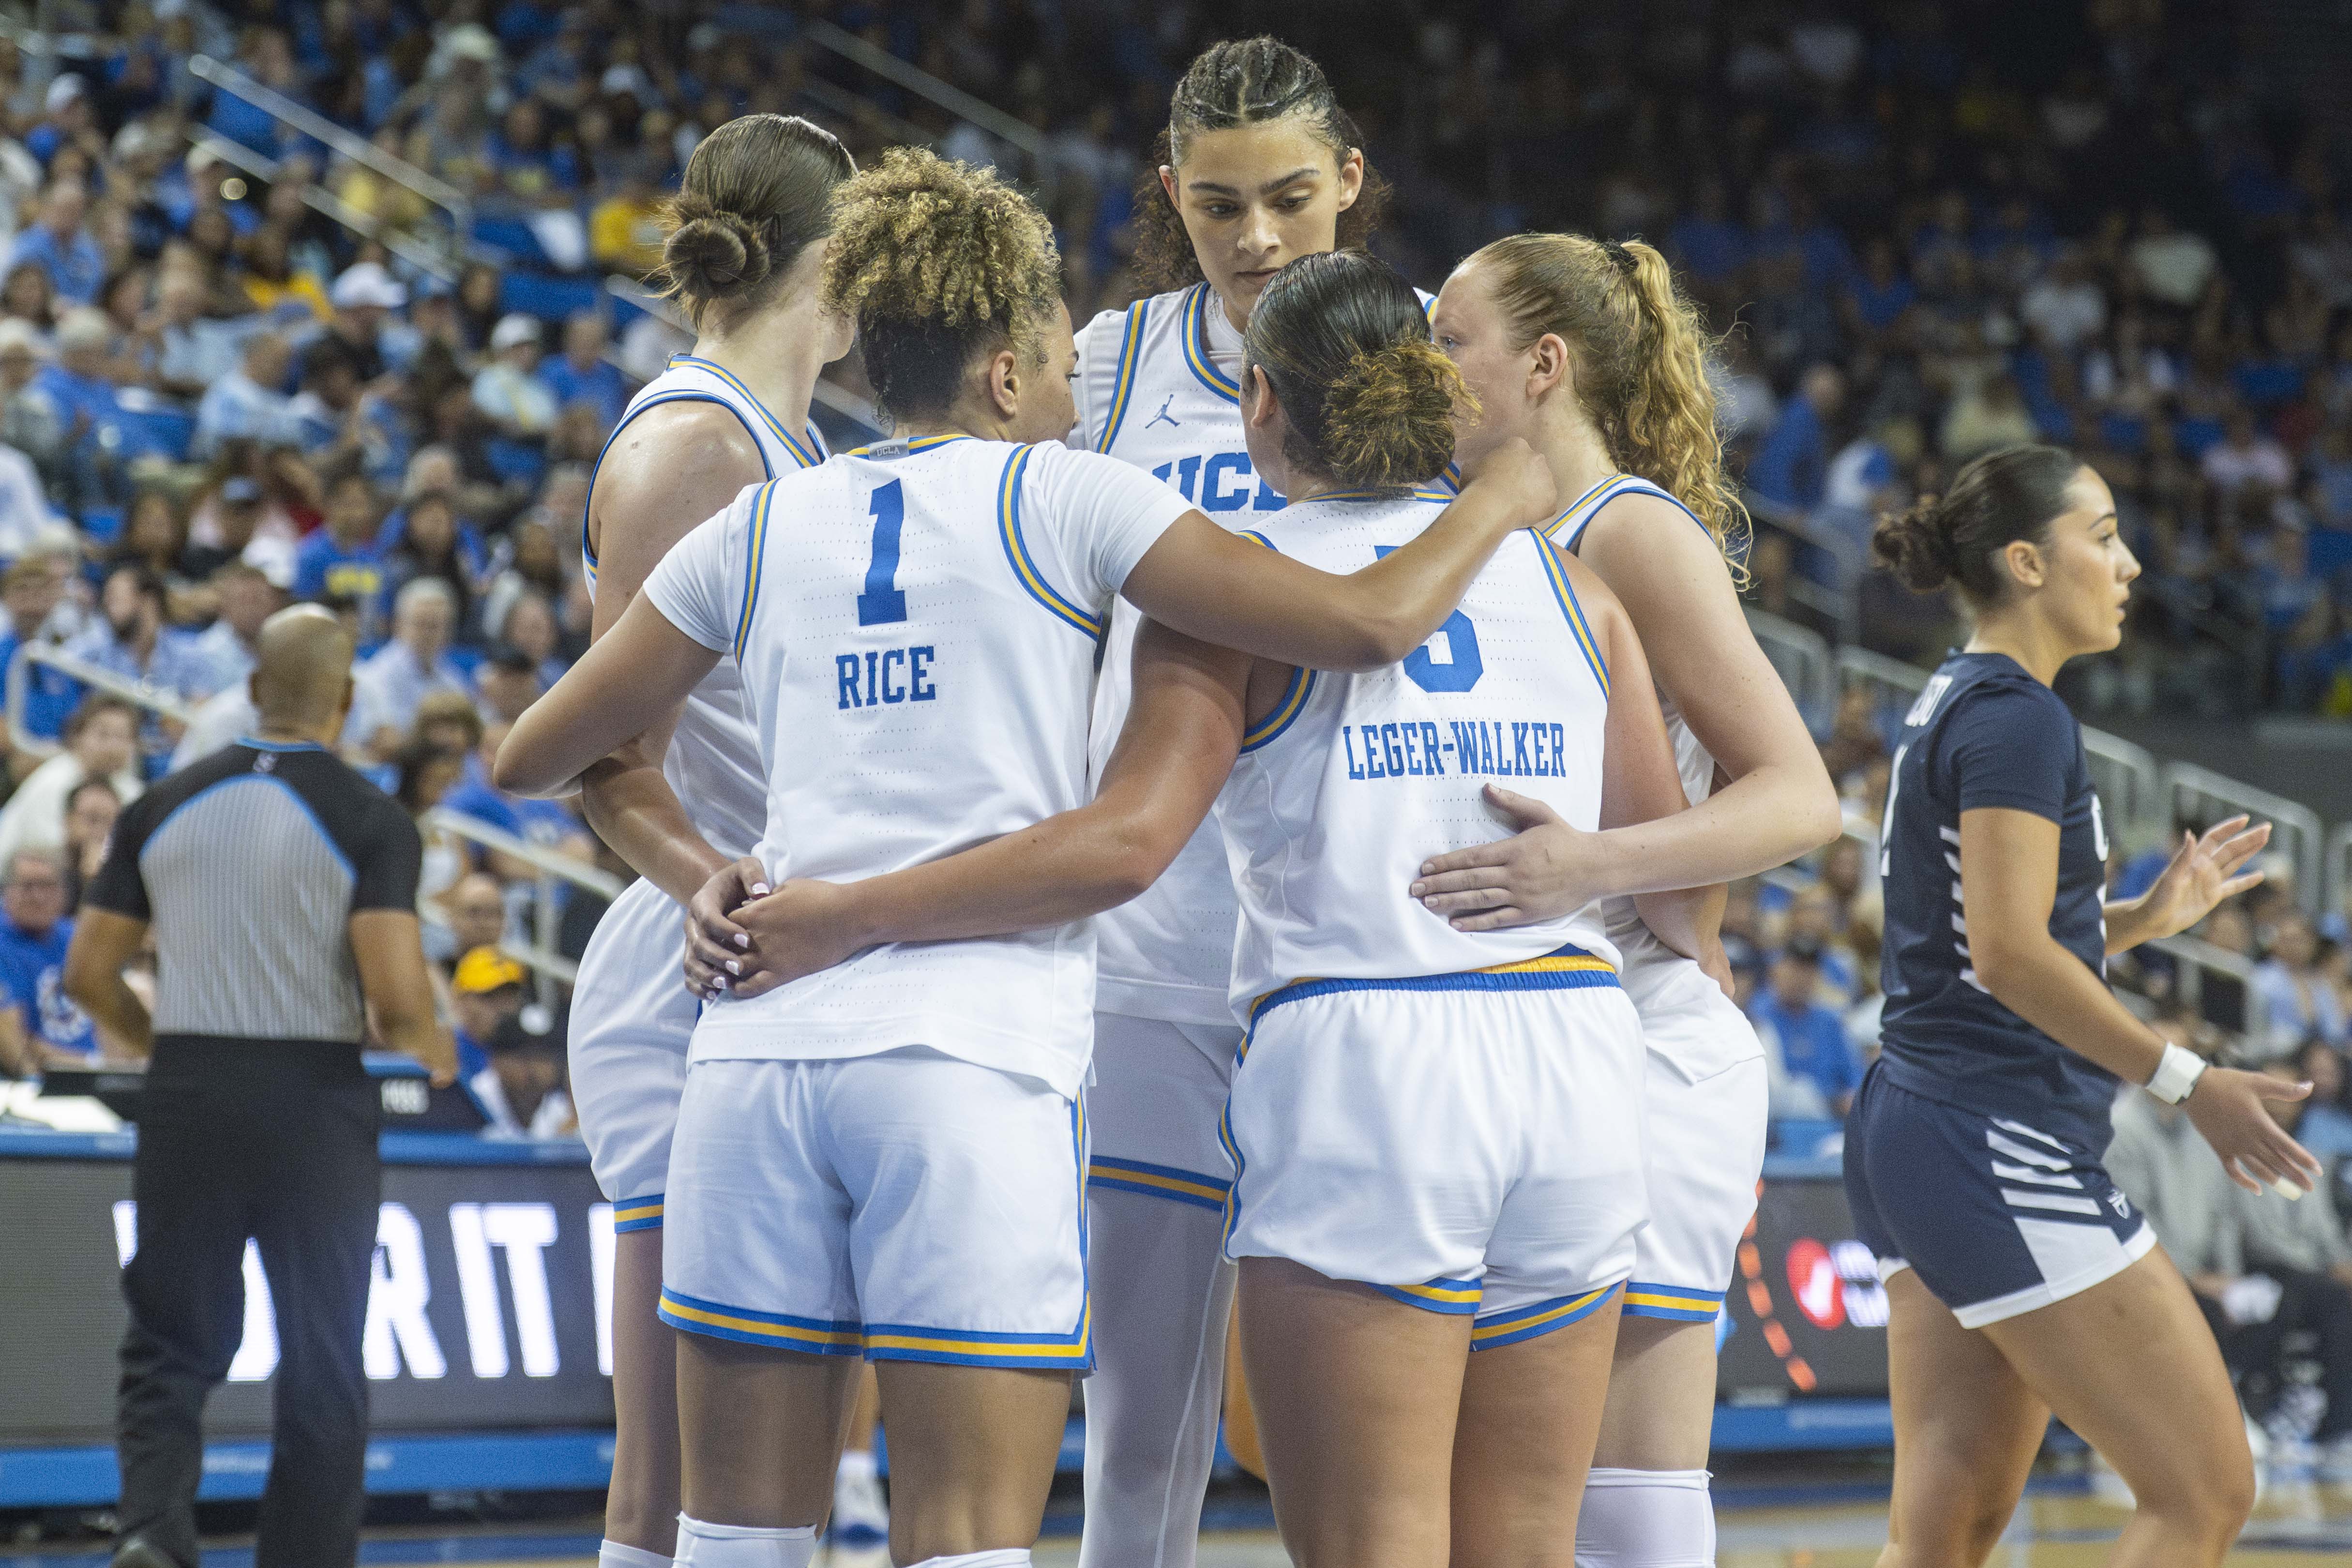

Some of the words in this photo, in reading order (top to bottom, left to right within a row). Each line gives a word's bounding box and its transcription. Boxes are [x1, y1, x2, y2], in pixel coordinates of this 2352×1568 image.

[876, 446, 901, 457] UCLA
[857, 478, 907, 626] 1
[836, 645, 936, 710] RICE
[1343, 721, 1566, 780] LEGER-WALKER
